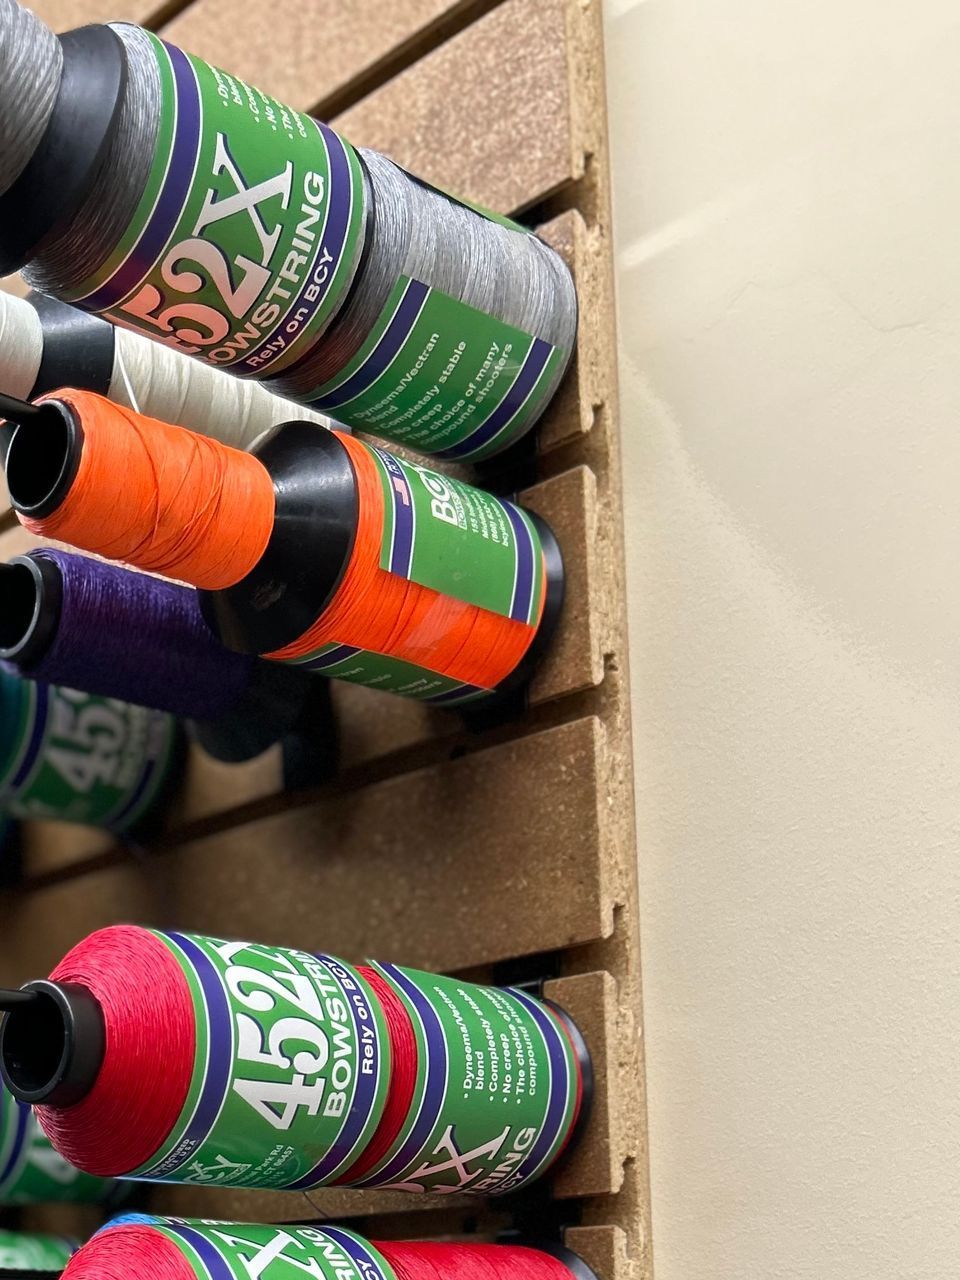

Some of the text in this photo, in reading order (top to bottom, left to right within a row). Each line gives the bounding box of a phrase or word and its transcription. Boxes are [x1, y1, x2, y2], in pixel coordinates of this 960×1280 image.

[203, 171, 325, 365] OWSTRING
[246, 246, 335, 367] Rely on BCY
[380, 384, 441, 430] Completely
[438, 340, 467, 384] stable
[429, 399, 466, 431] choice
[465, 382, 477, 397] of
[475, 341, 500, 382] many
[475, 342, 513, 404] shooters
[414, 403, 443, 428] creep
[288, 949, 352, 1118] BOWSTRIN
[322, 959, 375, 1075] Rely on BCY
[508, 1023, 525, 1066] choice
[474, 1051, 485, 1090] blend
[480, 1017, 500, 1093] Completely
[499, 1033, 512, 1094] No creep
[515, 1069, 526, 1095] The
[517, 1025, 538, 1096] compound
